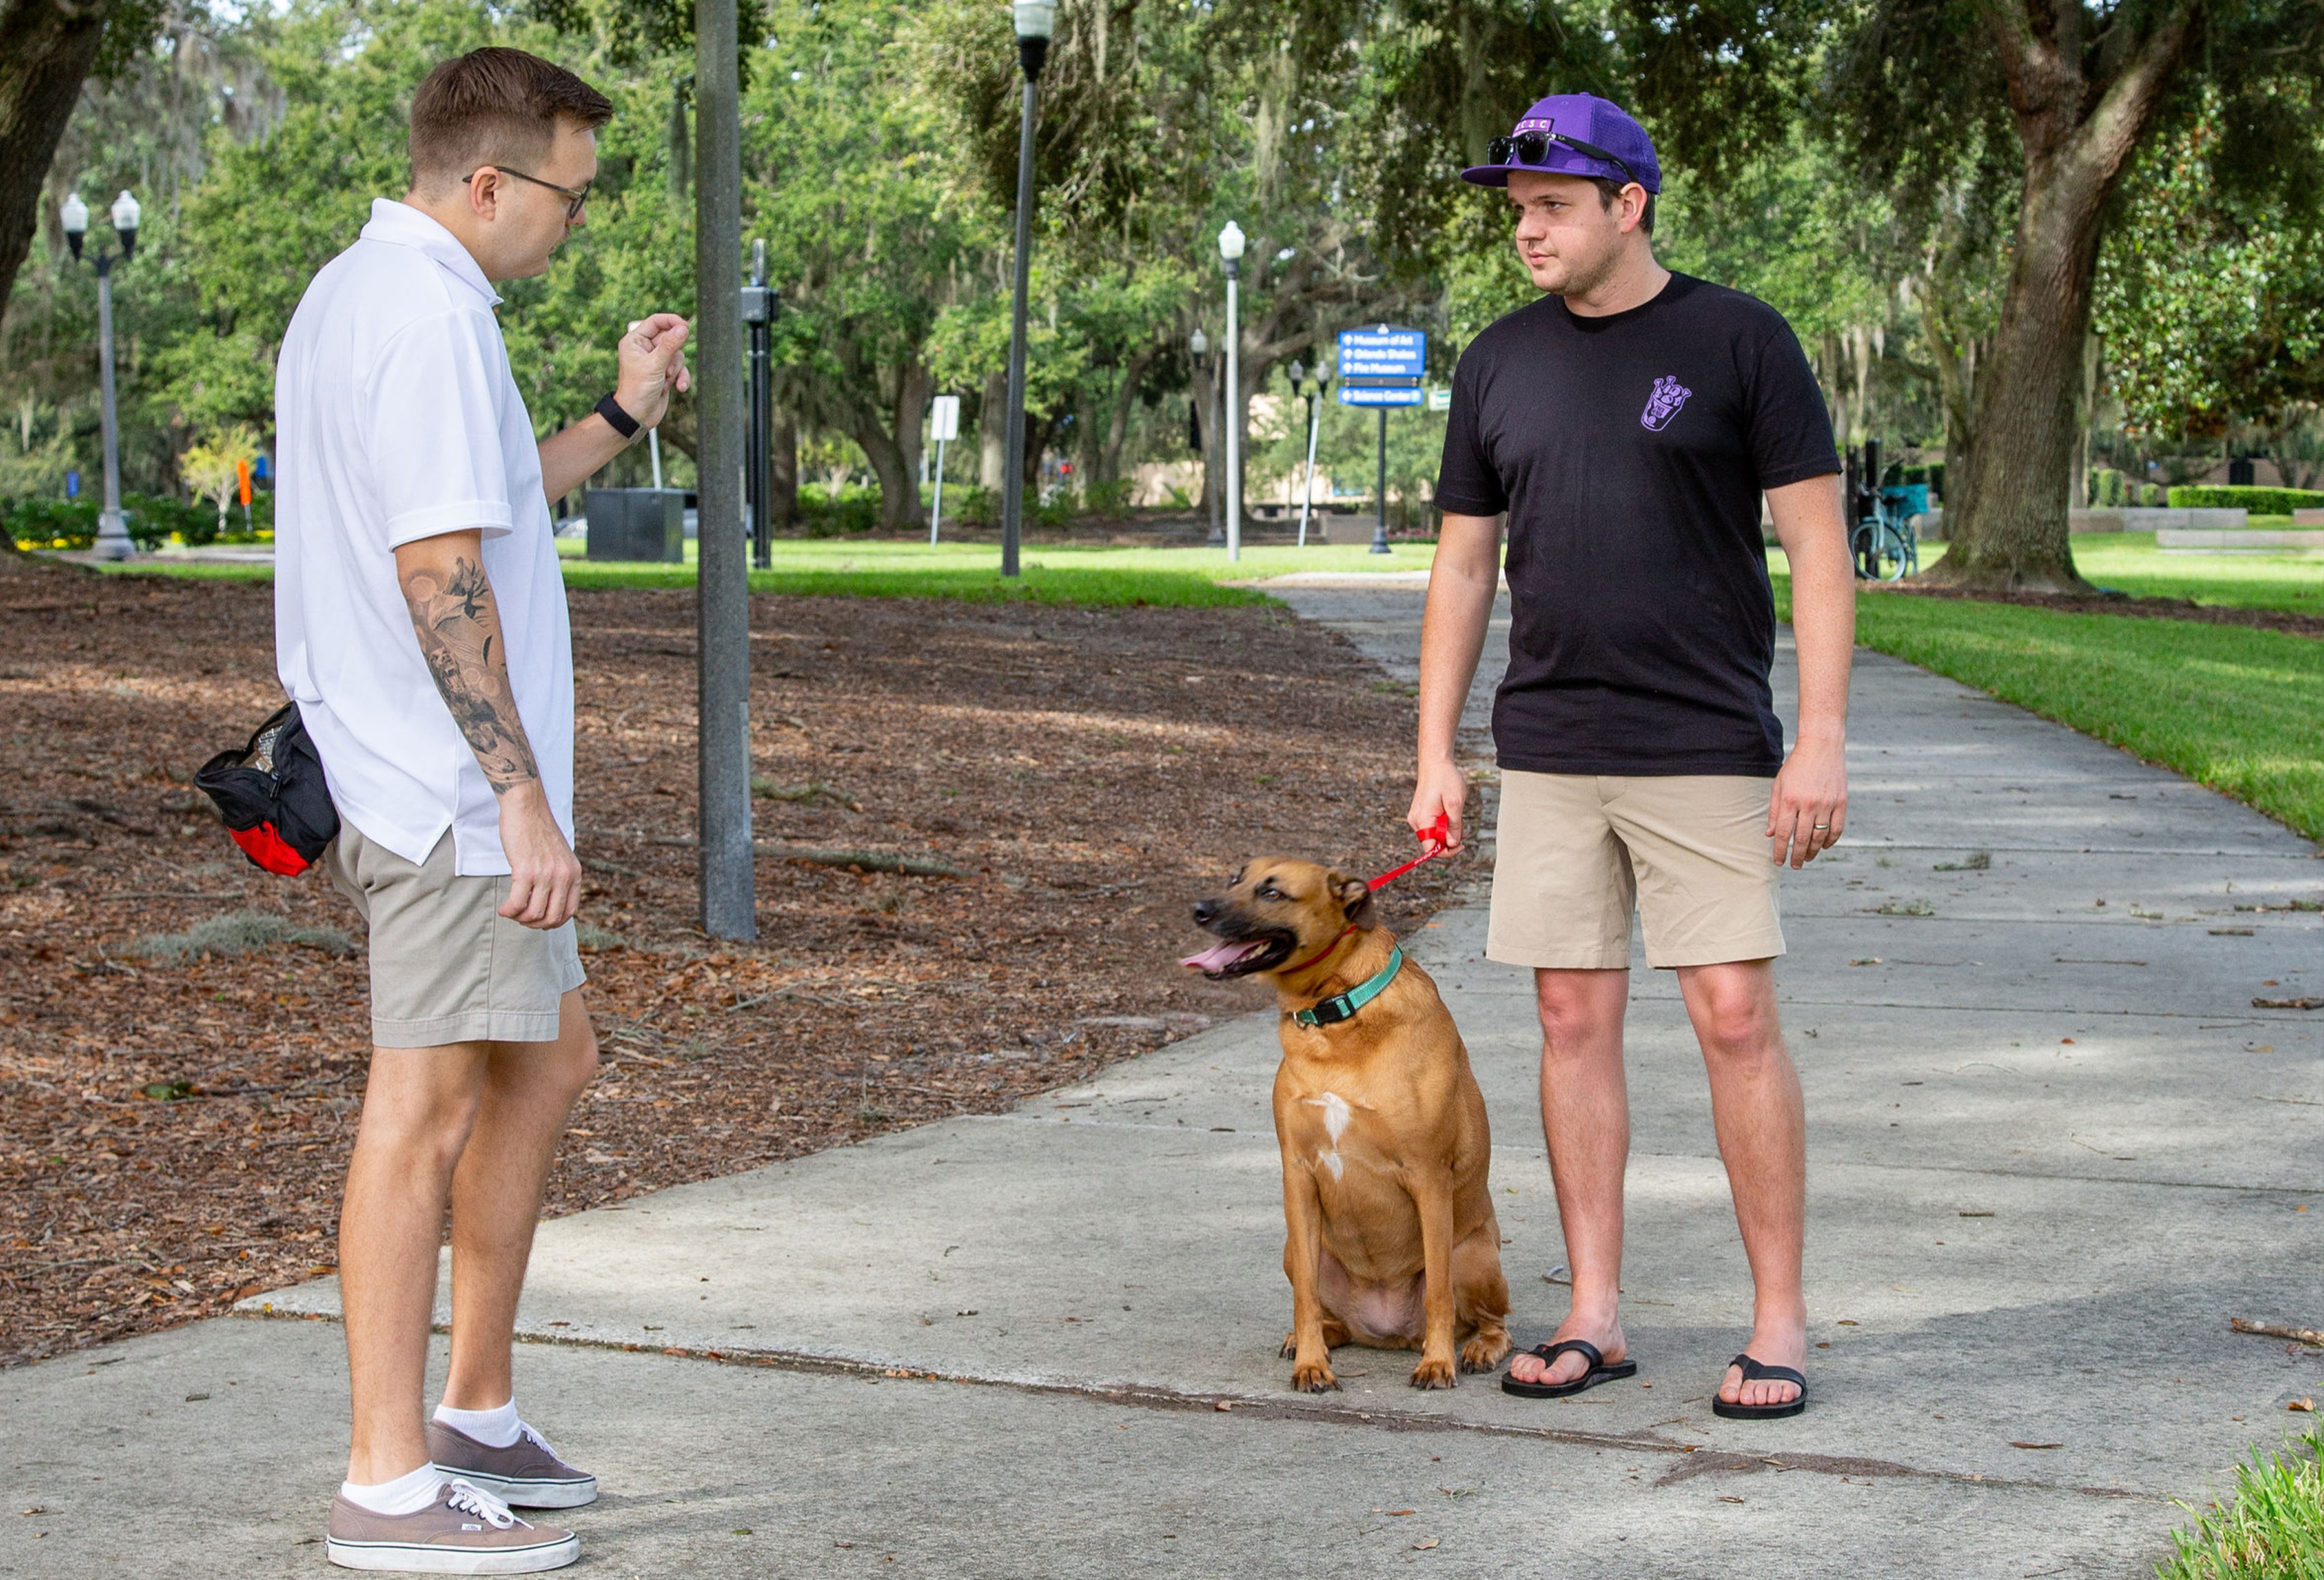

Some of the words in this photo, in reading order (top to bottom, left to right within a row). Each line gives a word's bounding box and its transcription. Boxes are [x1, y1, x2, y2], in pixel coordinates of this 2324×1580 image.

[1354, 335, 1389, 345] Museum
[1390, 335, 1400, 345] of
[1400, 335, 1413, 345] Art
[1354, 349, 1387, 360] Orlando
[1353, 362, 1369, 373] Fire
[1370, 363, 1406, 373] Museum
[1353, 390, 1383, 401] Science
[1384, 390, 1411, 402] Center
